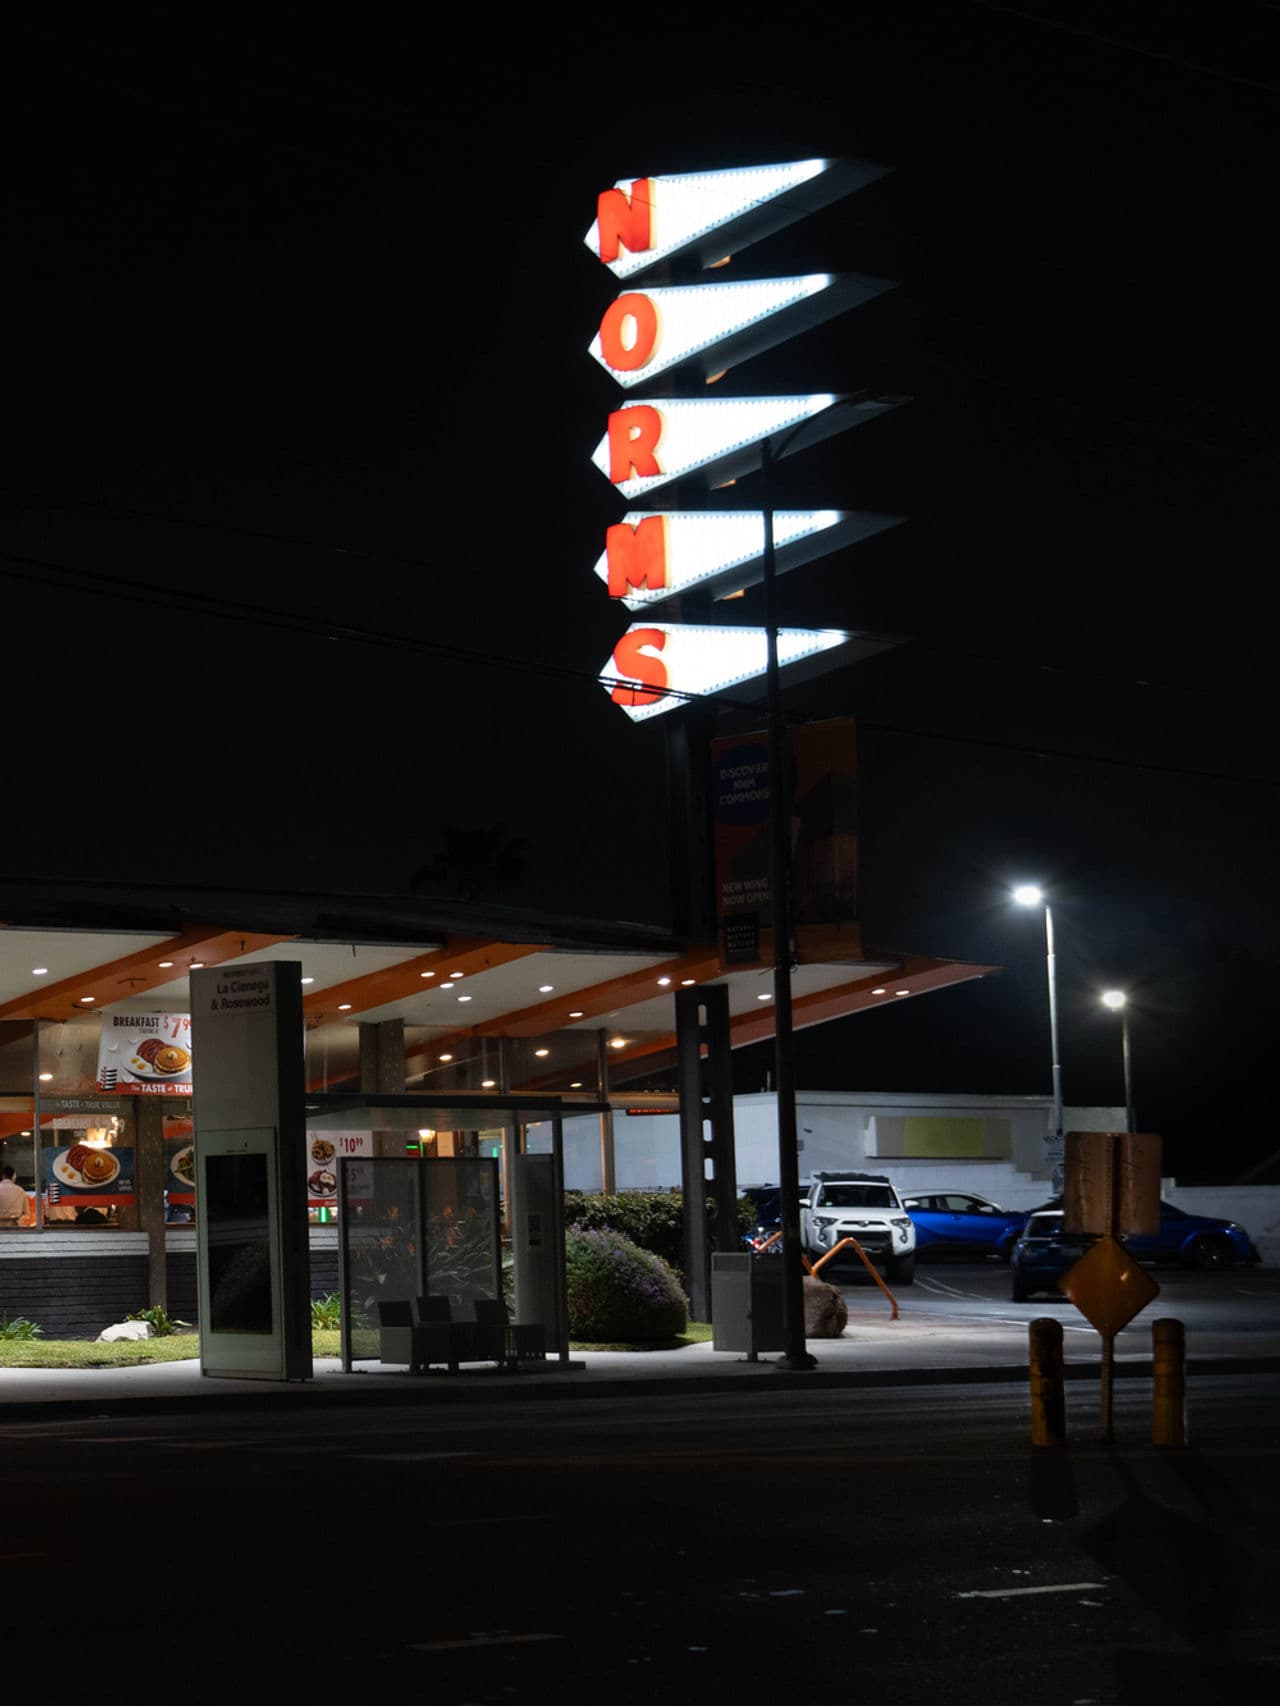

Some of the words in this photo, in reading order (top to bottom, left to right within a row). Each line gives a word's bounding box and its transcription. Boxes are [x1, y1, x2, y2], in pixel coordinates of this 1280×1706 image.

[595, 177, 668, 706] NORMS
[216, 983, 229, 994] La
[230, 979, 269, 994] Cienega
[221, 993, 270, 1009] Rosewood
[112, 1016, 160, 1027] BREAKFAST
[141, 1083, 166, 1093] TASTE
